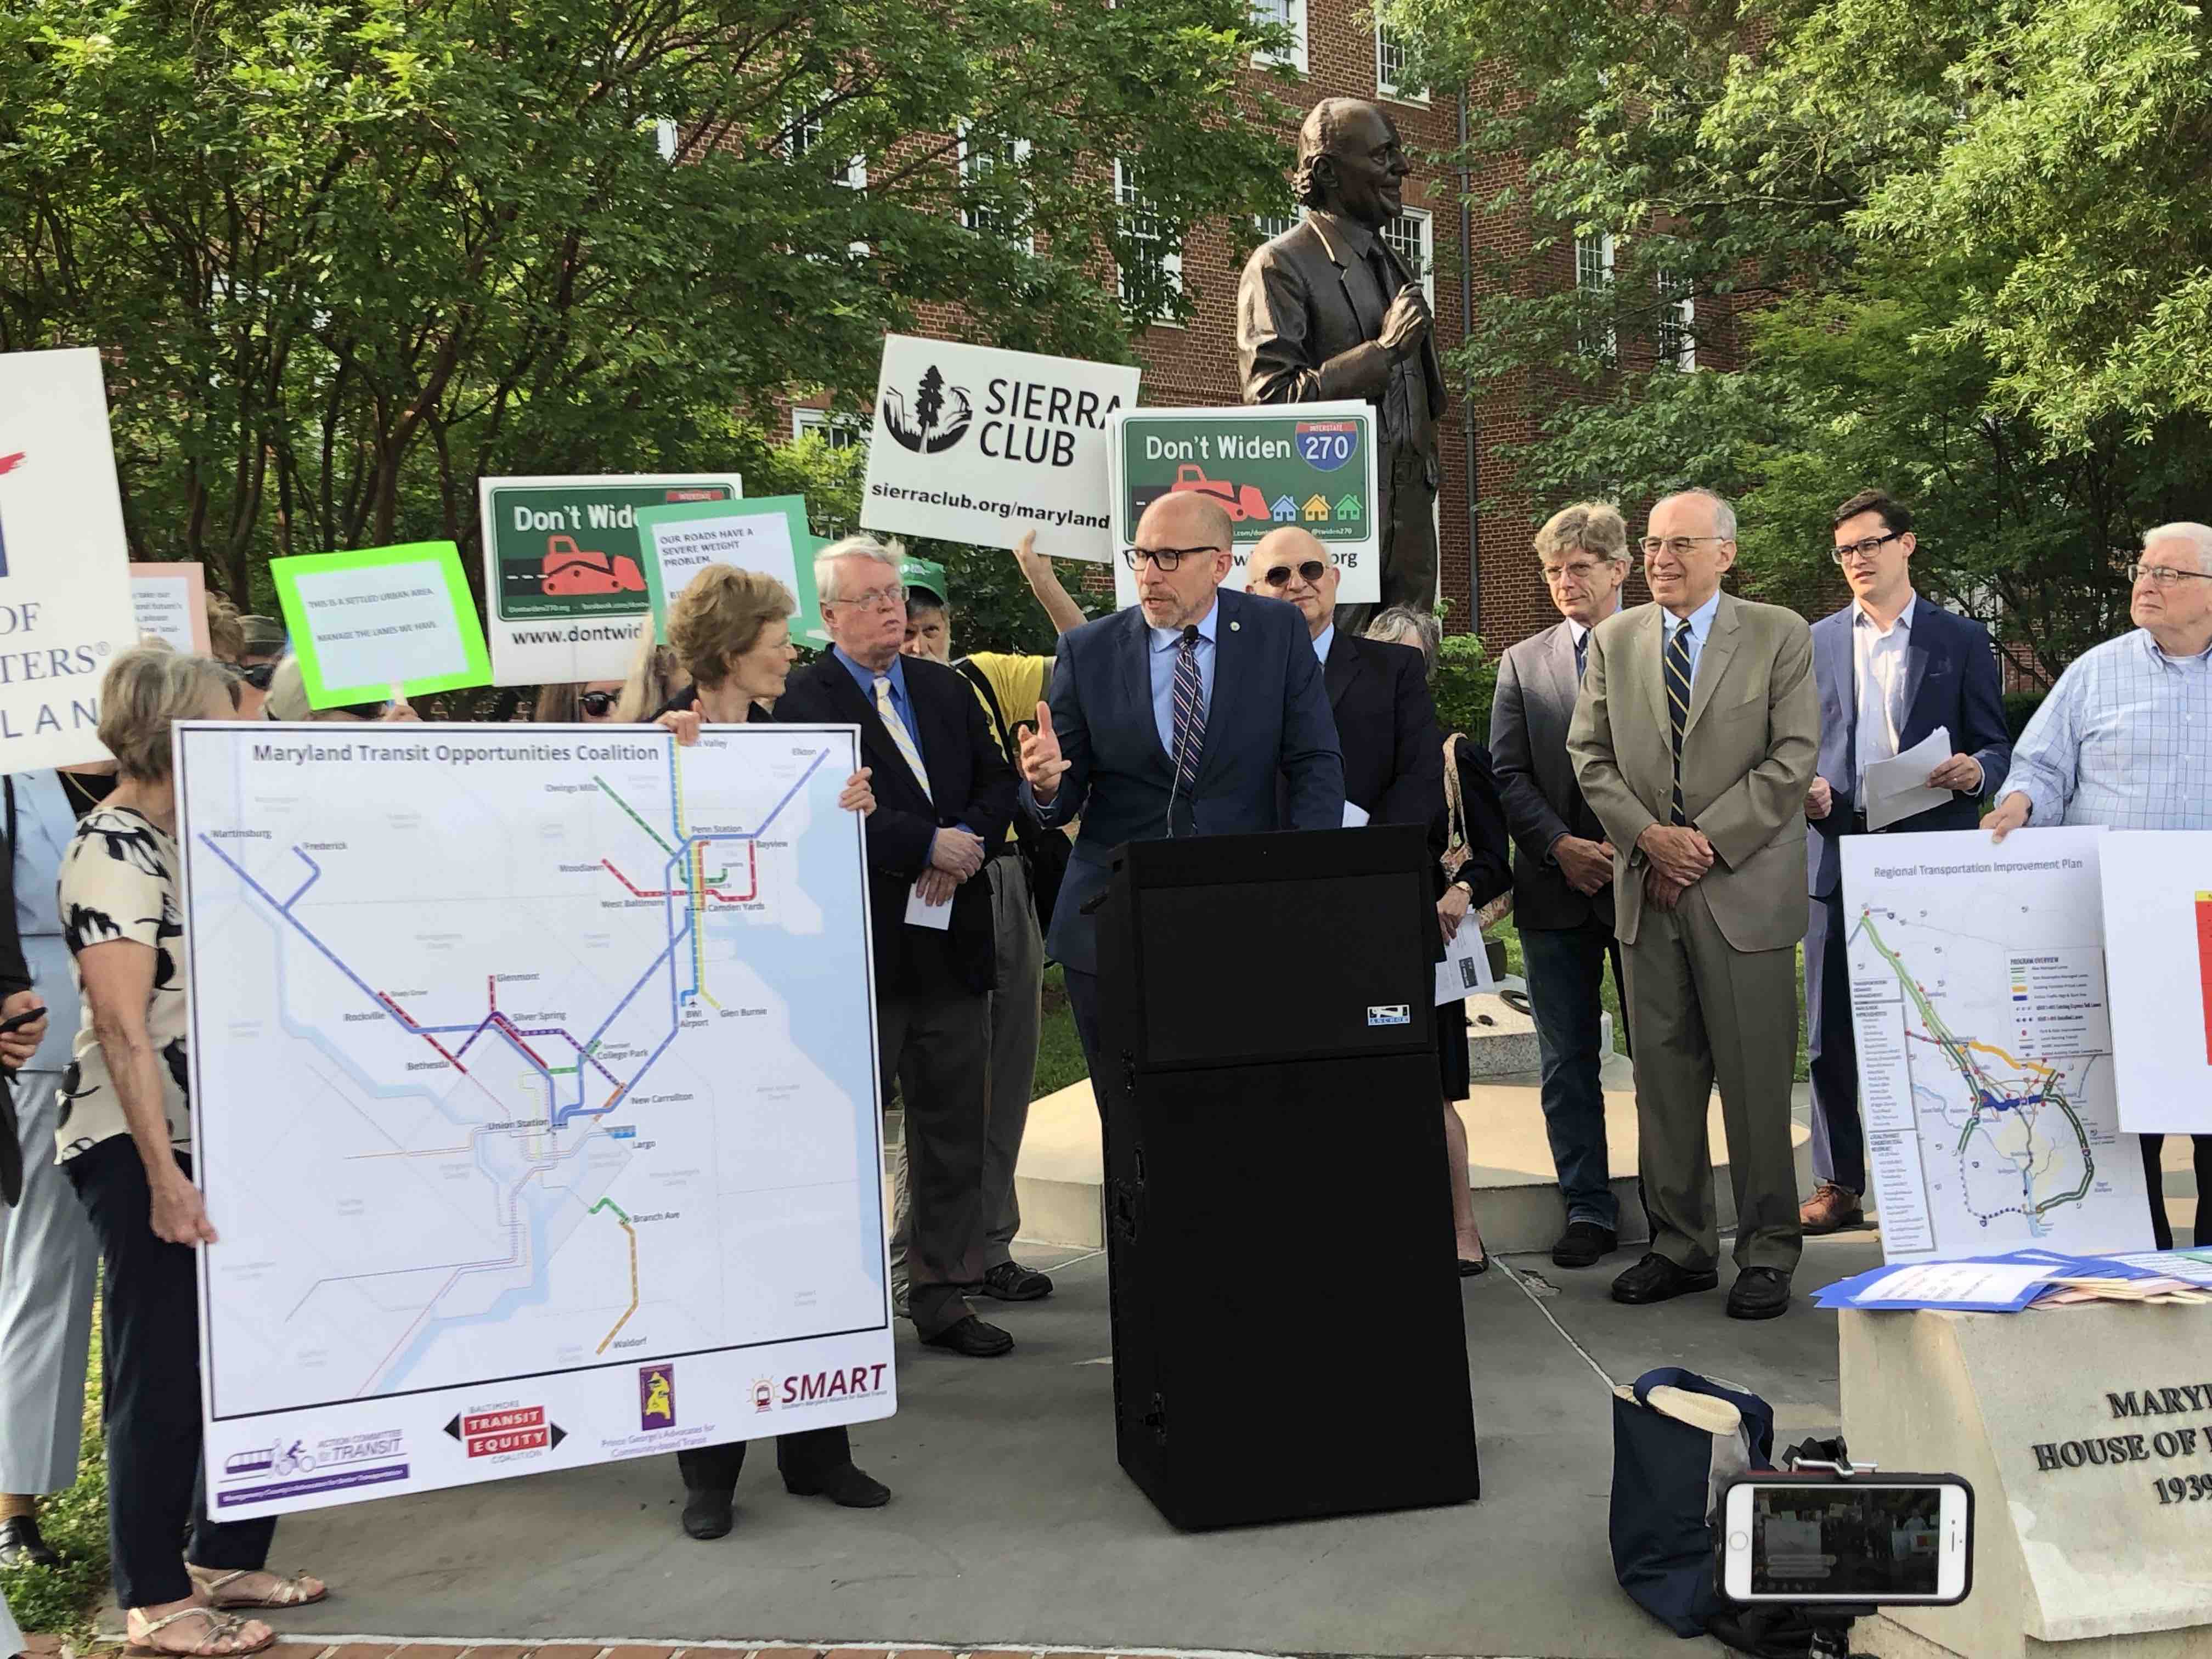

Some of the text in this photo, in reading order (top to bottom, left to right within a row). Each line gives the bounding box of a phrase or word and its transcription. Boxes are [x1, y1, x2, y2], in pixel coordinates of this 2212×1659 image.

[985, 379, 1121, 430] SIERRA
[980, 420, 1076, 467] CLUB
[1146, 435, 1291, 460] Don't Widen
[1306, 436, 1348, 459] 270
[872, 483, 1110, 530] sierraclub.org/maryland
[514, 504, 582, 531] Don't
[660, 528, 754, 545] OUR ROADS HAVE A
[662, 541, 740, 556] SEVERE WEIGHT
[703, 739, 728, 749] Valley
[253, 743, 659, 766] Maryland Transit Opportunities Coalition
[545, 783, 599, 794] Owings Mills
[211, 828, 273, 840] Martinsburg
[713, 825, 742, 833] Station
[303, 842, 348, 850] Frederick
[756, 840, 788, 850] Bayview
[560, 864, 604, 873] Woodlawn
[1874, 858, 2084, 879] Regional Transportation Improvement Plan
[601, 898, 665, 909] West Baltimore
[708, 902, 765, 912] Camden Yards
[496, 973, 540, 982] Glenmont
[343, 1012, 386, 1022] Rockville
[514, 1011, 567, 1022] Silver Spring
[686, 1009, 702, 1018] BWI
[720, 1008, 768, 1018] Glen Burnie
[680, 1019, 709, 1029] Airport
[597, 1048, 648, 1062] College Park
[407, 1060, 450, 1070] Bethesda
[631, 1093, 694, 1105] New Carrollton
[488, 1118, 549, 1130] Union Station
[633, 1140, 656, 1150] Largo
[633, 1211, 680, 1223] Branch Ave
[614, 1336, 647, 1348] Waldorf
[782, 1363, 887, 1403] SMART
[470, 1401, 519, 1414] BALTIMORE
[469, 1410, 539, 1431] TRANSIT
[318, 1429, 403, 1448] ACTION COMMITTEE
[473, 1431, 544, 1453] EQUITY
[333, 1438, 403, 1460] TRANSIT
[2032, 1434, 2150, 1471] HOUSE
[2153, 1427, 2196, 1458] OF
[491, 1450, 543, 1464] COALITION
